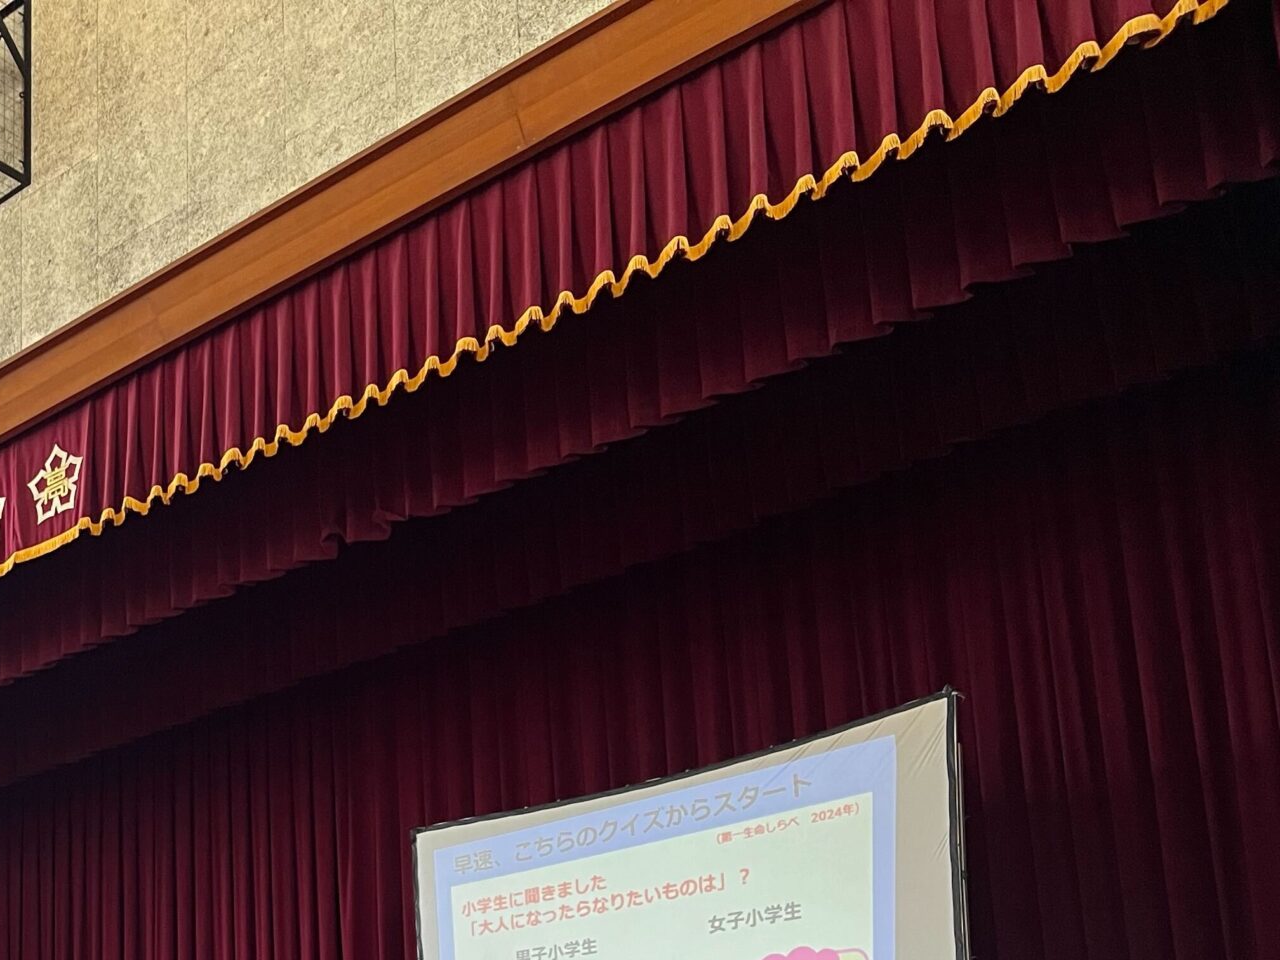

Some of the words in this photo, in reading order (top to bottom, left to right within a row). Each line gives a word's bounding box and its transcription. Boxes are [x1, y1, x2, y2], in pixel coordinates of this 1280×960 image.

[454, 774, 812, 875] 早速、こちらのクイズからスタート
[462, 875, 607, 917] 小学生に聞きました
[708, 902, 802, 934] 女子小学生
